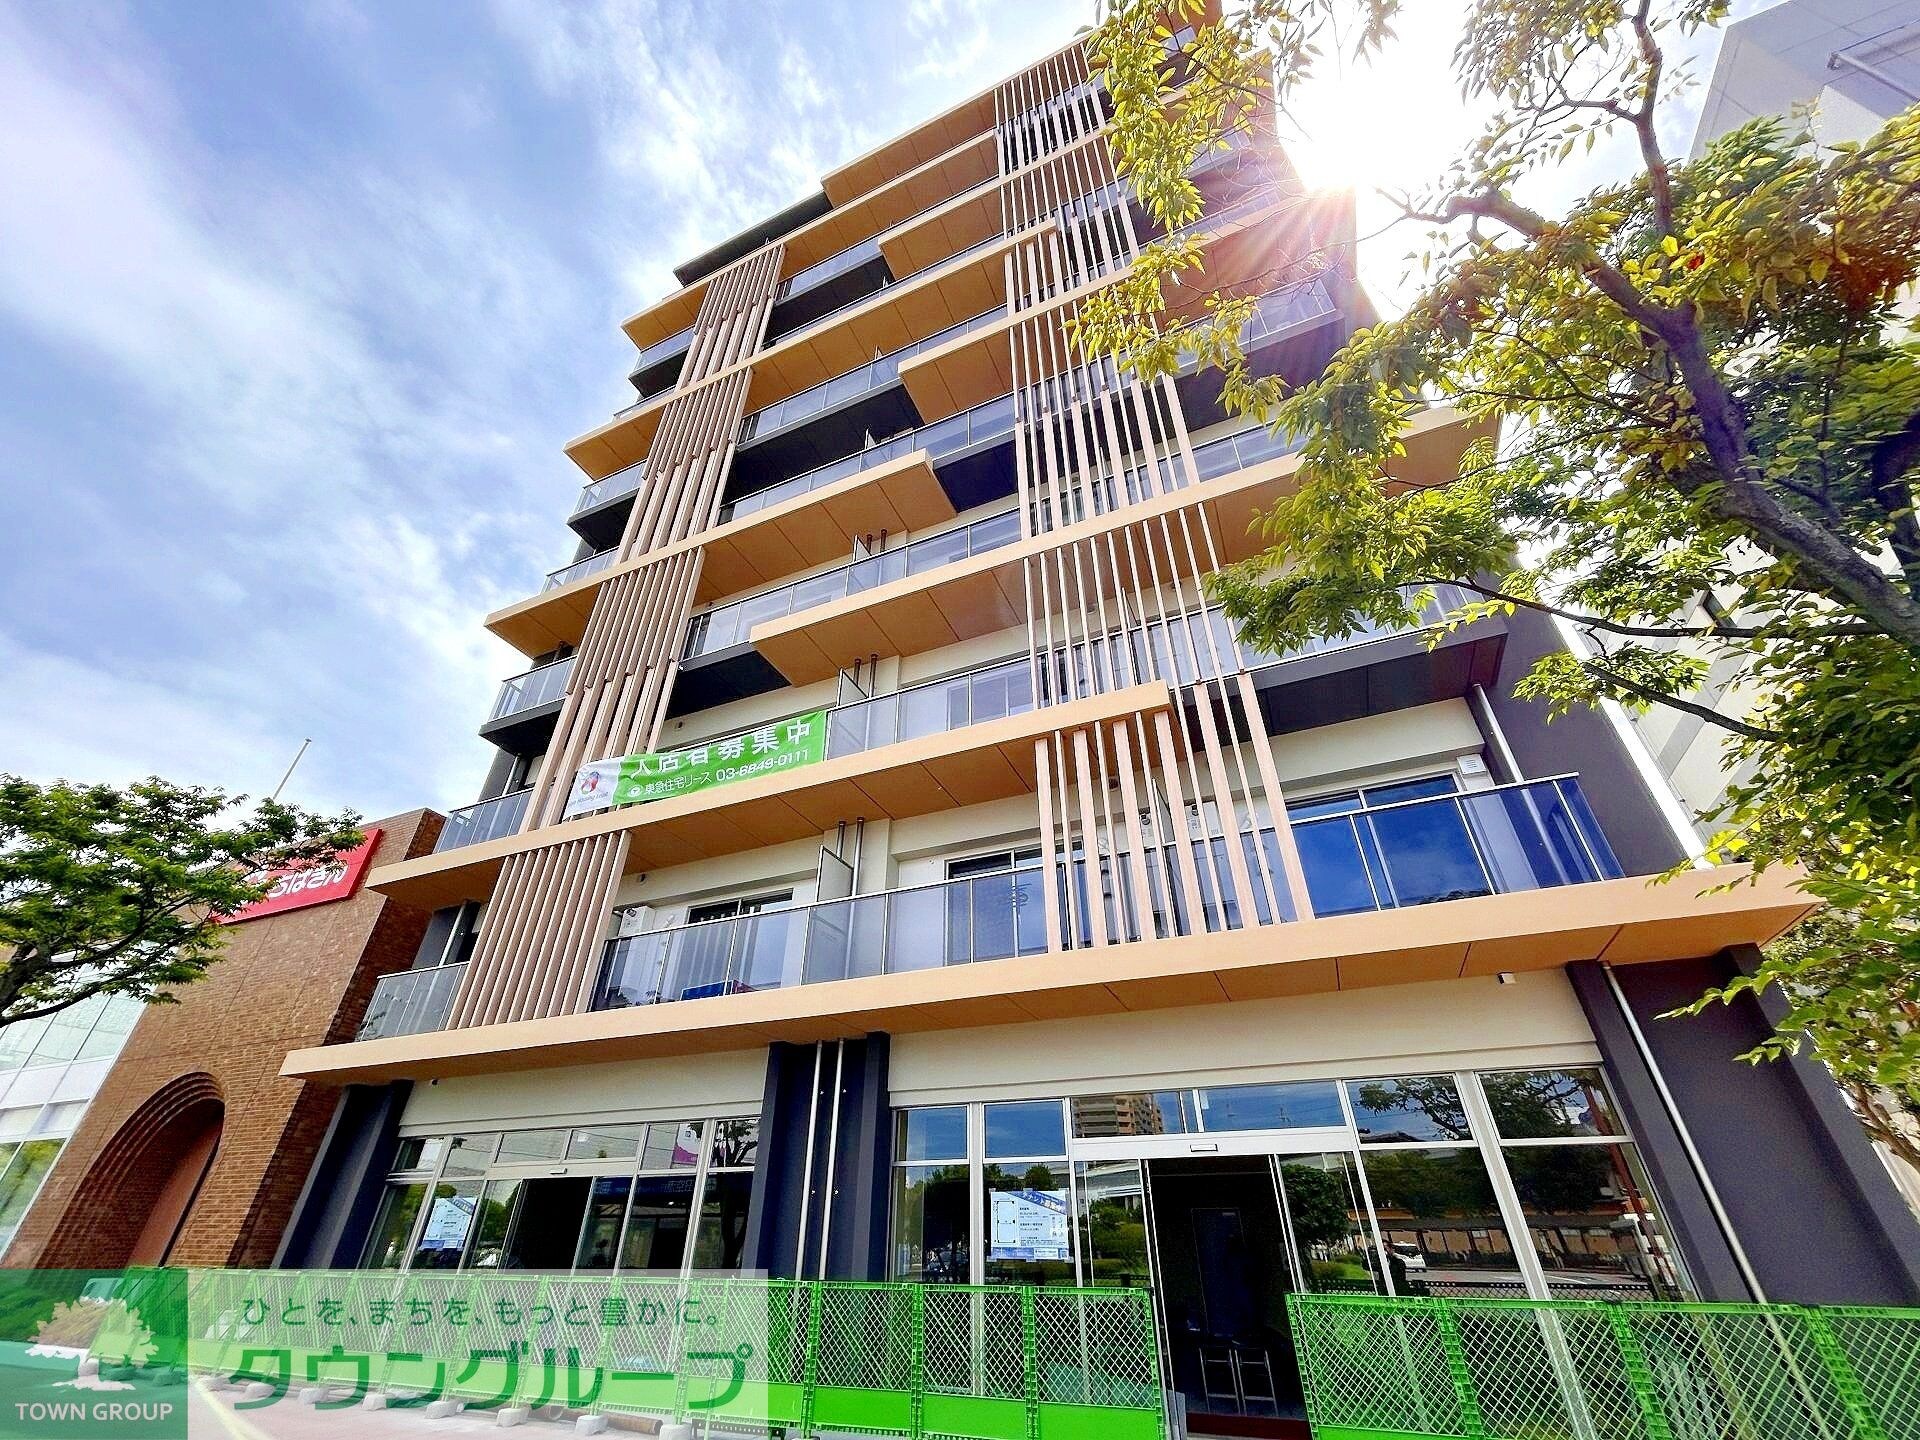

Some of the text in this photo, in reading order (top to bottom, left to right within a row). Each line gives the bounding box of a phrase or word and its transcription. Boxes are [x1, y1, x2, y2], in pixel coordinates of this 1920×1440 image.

[644, 772, 712, 795] 東急住宅リース
